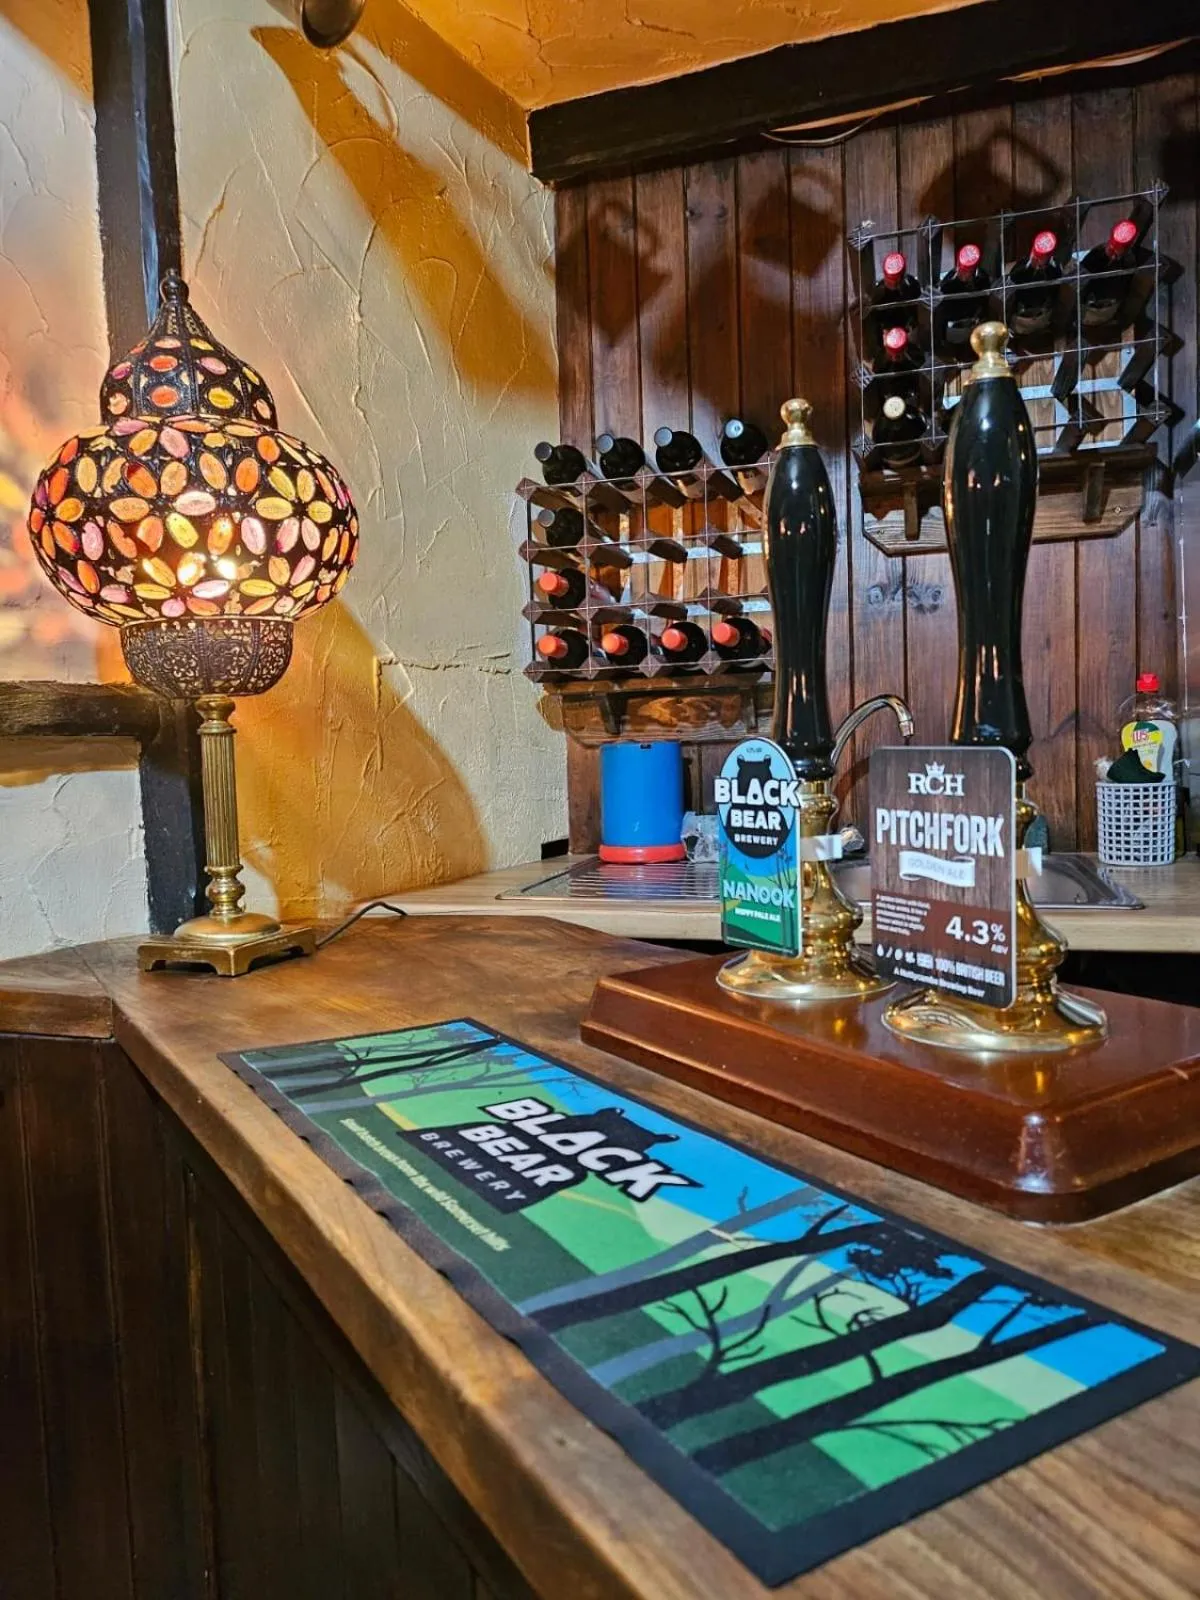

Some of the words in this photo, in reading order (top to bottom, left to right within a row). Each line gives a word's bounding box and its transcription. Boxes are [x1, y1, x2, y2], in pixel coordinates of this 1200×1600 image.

[714, 778, 800, 806] BLACK
[908, 772, 965, 797] RCH
[730, 809, 781, 830] BEAR
[876, 808, 1004, 858] PITCHFORK
[734, 833, 779, 846] BREWERY
[948, 867, 965, 879] ALE
[723, 880, 795, 909] NANOOK
[945, 916, 1006, 945] 4.3%
[459, 1124, 585, 1187] BEAR
[485, 1098, 699, 1198] BLACK
[419, 1132, 527, 1201] BREWERY
